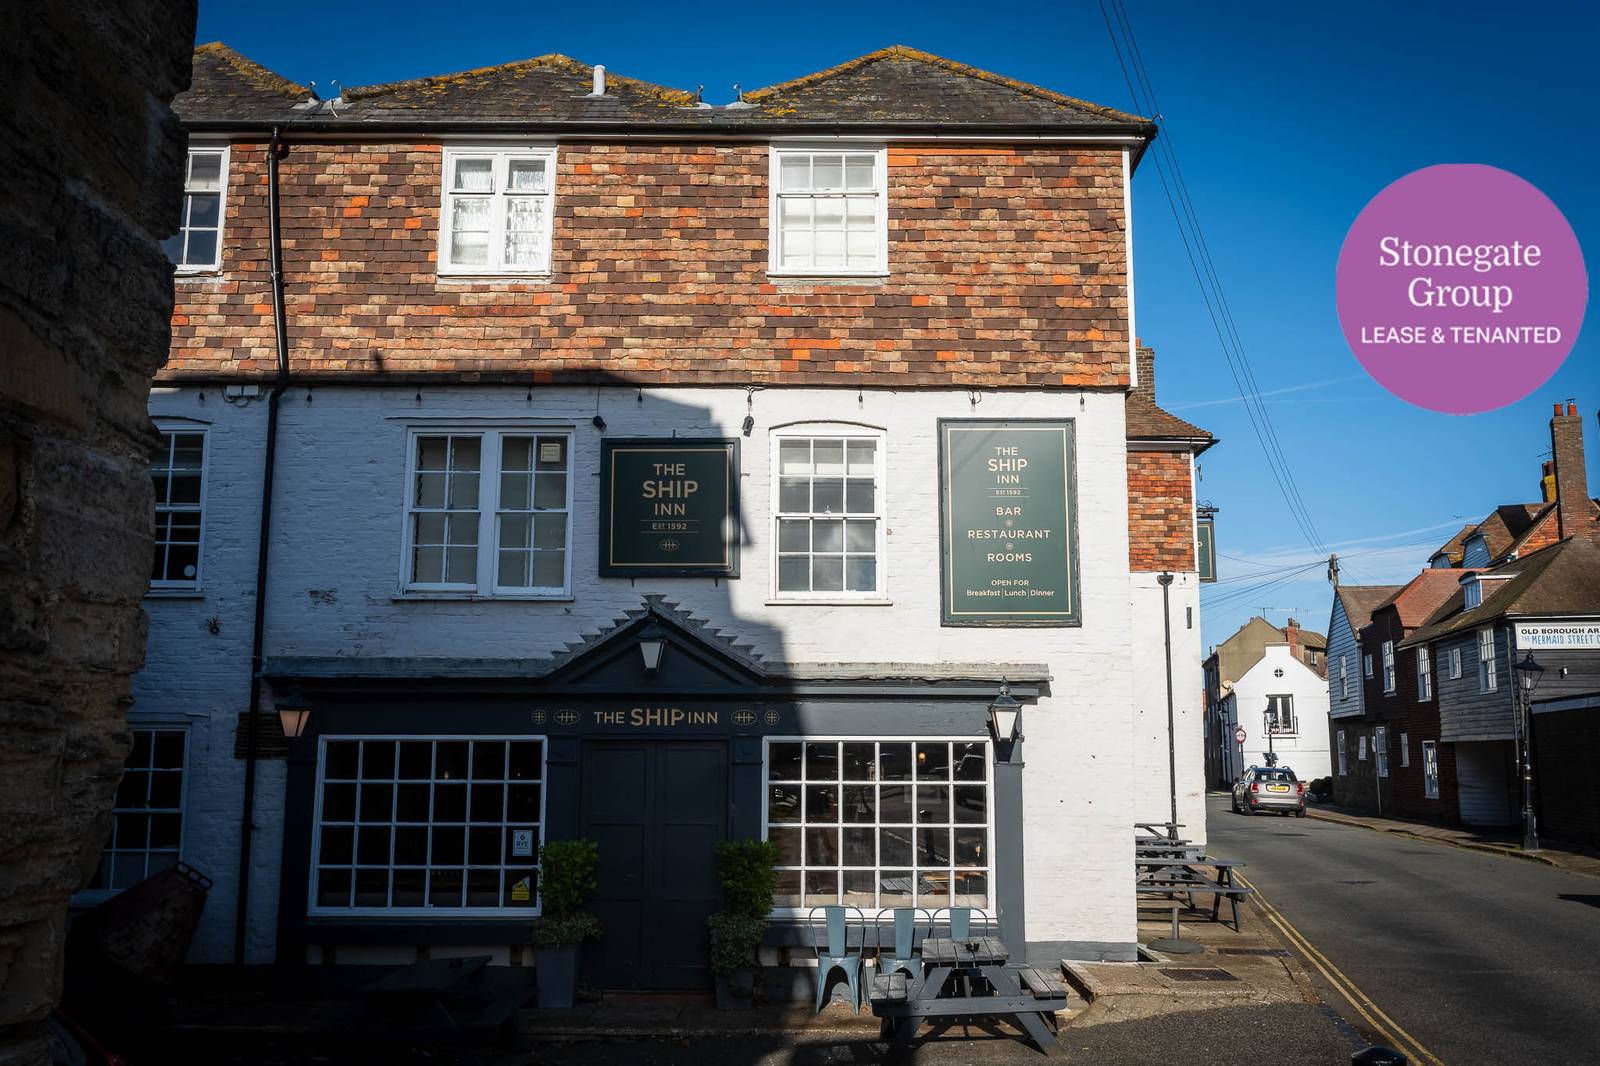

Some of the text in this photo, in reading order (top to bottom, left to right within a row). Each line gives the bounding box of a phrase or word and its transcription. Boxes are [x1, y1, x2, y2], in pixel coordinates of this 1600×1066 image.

[994, 446, 1019, 456] THE
[653, 463, 686, 476] THE
[987, 458, 1028, 472] SHIP
[996, 474, 1020, 484] INN
[642, 480, 698, 498] SHIP
[654, 503, 686, 516] INN
[996, 506, 1022, 516] BAR
[667, 522, 688, 530] 1592
[967, 529, 1051, 539] RESTAURANT
[987, 552, 1033, 562] ROOMS
[966, 589, 1055, 597] Breakfast Lunch Dinner
[1541, 627, 1585, 635] BOROUGH
[1531, 635, 1565, 645] MERMAID
[1567, 634, 1594, 645] STREET
[593, 708, 718, 726] THE SHIP INN
